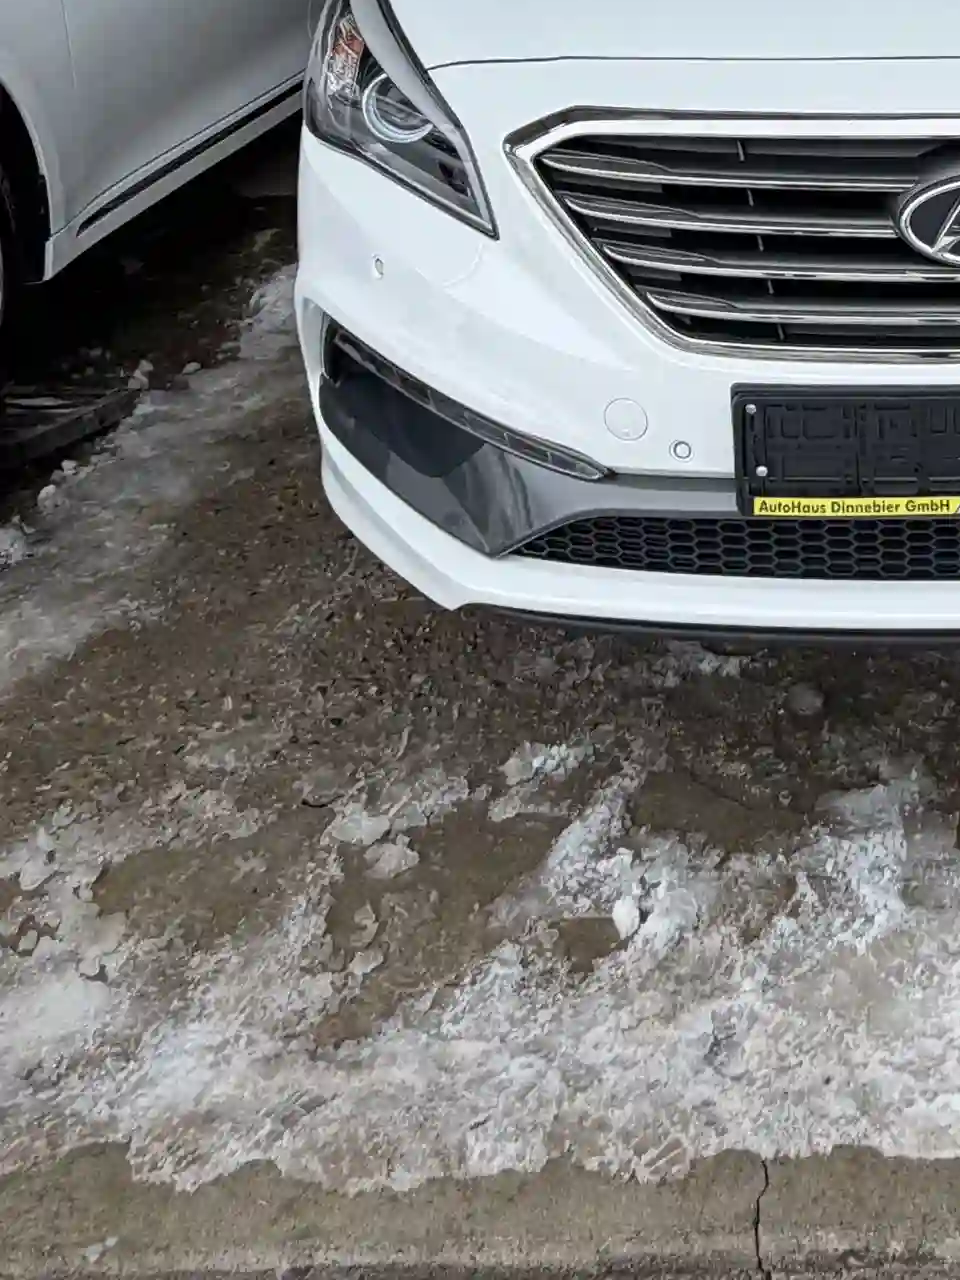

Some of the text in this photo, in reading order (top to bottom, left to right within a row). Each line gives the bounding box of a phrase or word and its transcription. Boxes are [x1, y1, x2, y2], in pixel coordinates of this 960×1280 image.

[759, 499, 826, 514] AutoHaus
[830, 499, 901, 514] Dinnebier
[905, 499, 950, 512] GmbH
